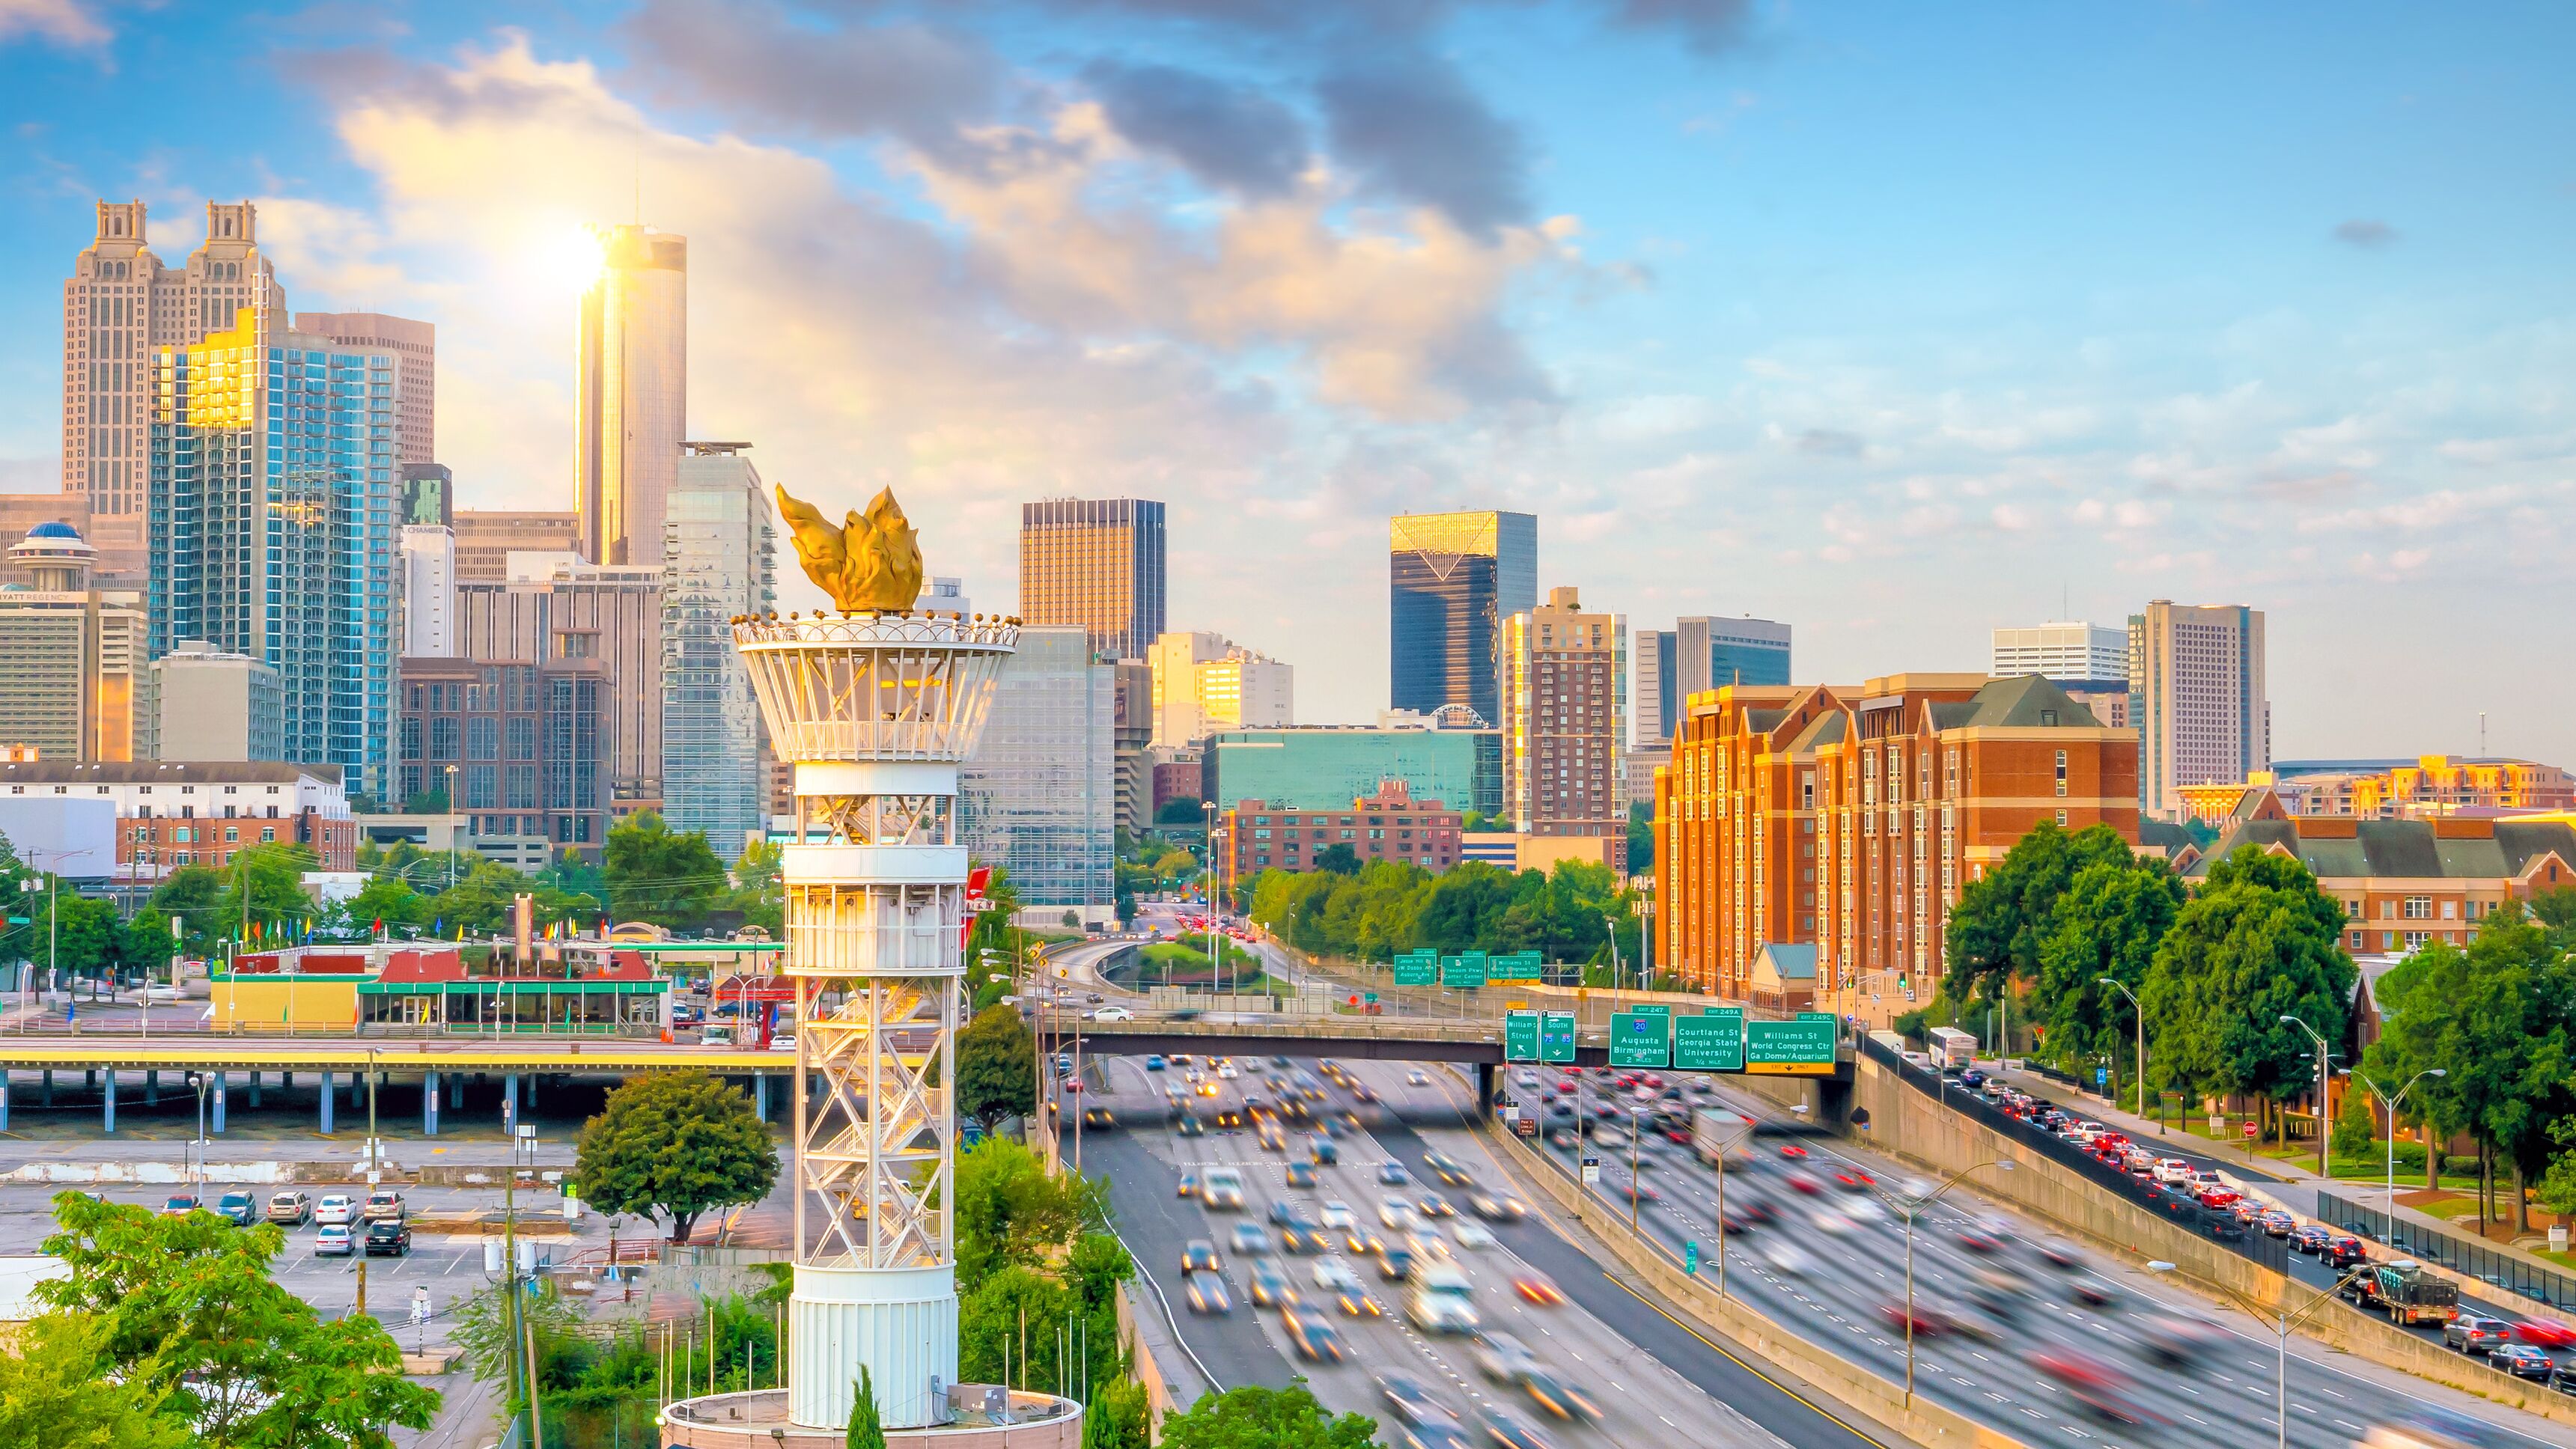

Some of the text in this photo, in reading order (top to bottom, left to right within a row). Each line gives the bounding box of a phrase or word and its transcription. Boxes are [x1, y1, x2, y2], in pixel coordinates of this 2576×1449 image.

[1621, 1037, 1659, 1046] Augusta
[1678, 1039, 1711, 1048] Georgia
[1614, 1046, 1666, 1056] Birmingham
[1777, 1043, 1812, 1052] Congress
[1684, 1049, 1732, 1058] University
[1764, 1052, 1830, 1061] Dome/Aquarium
